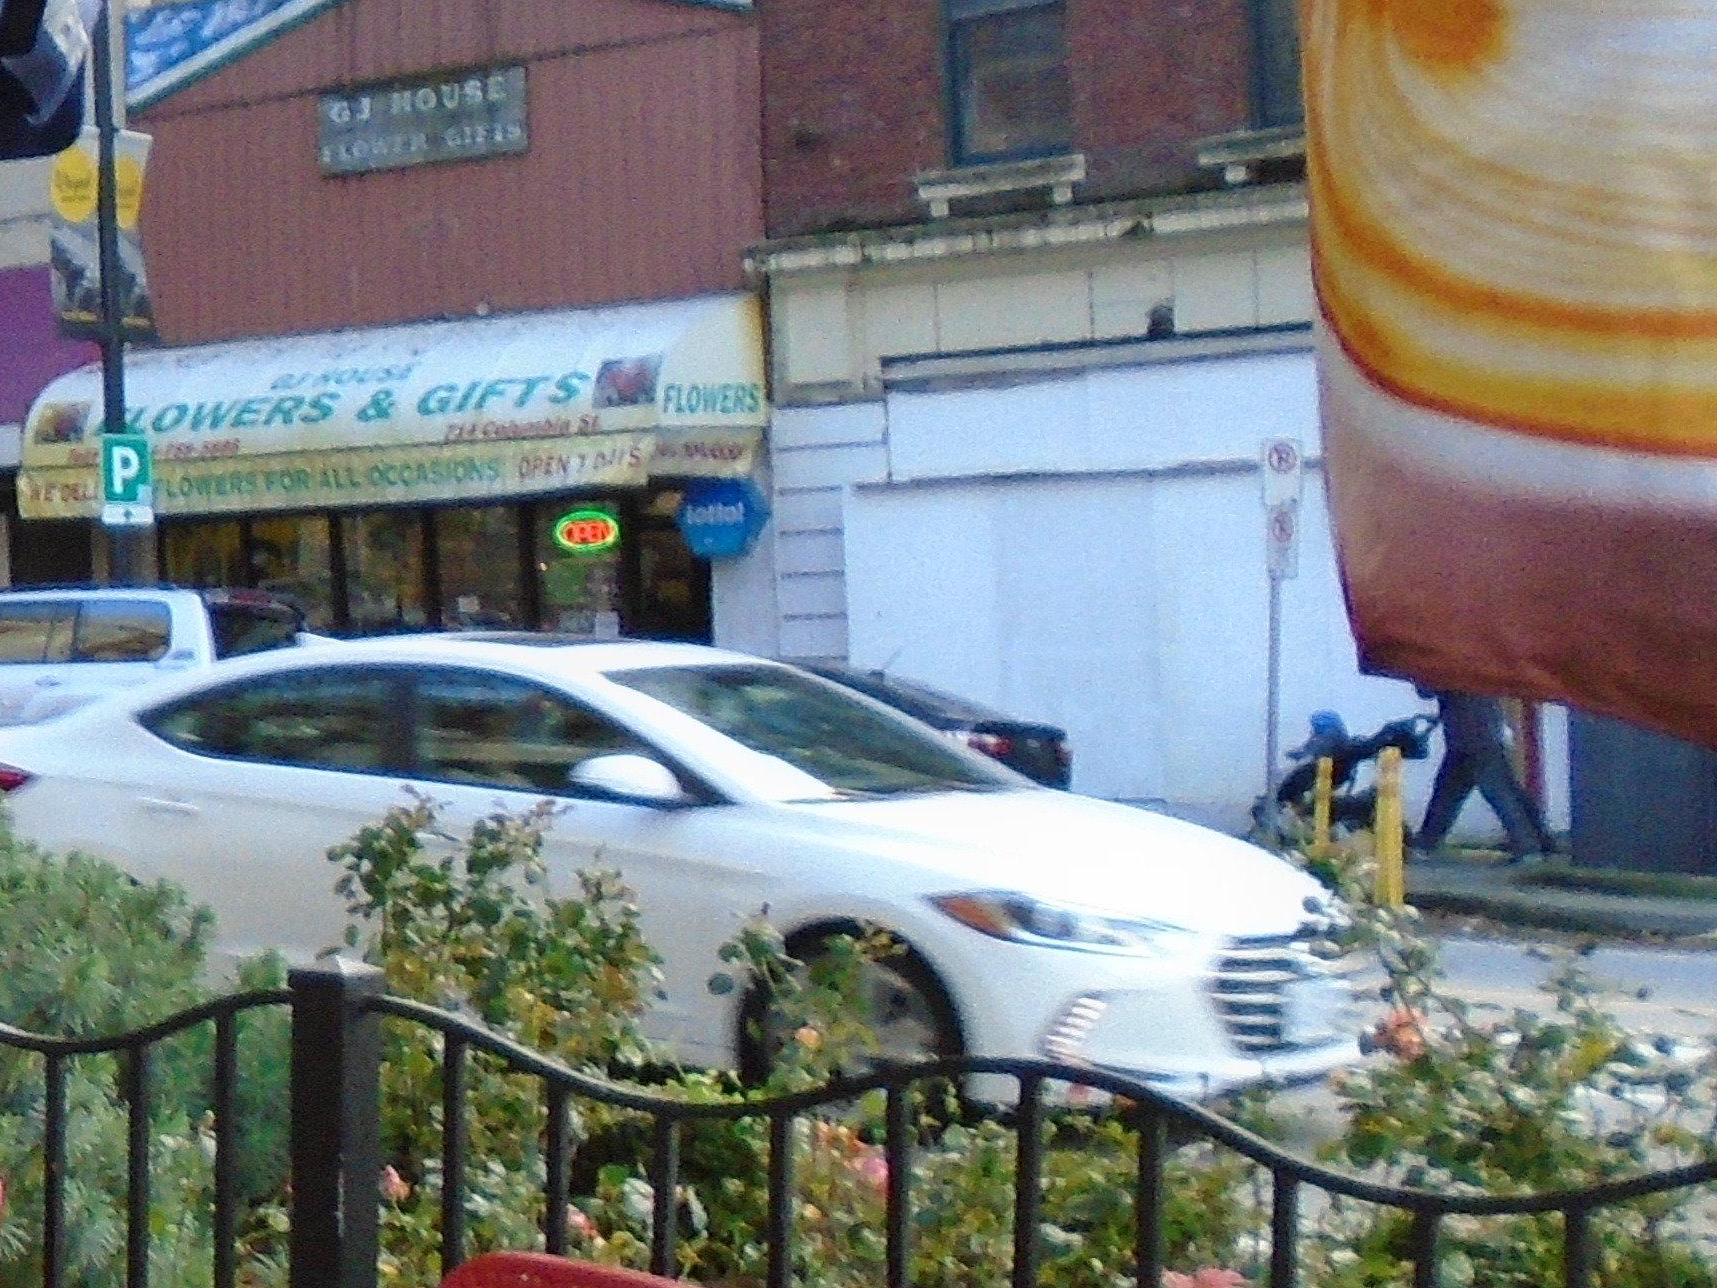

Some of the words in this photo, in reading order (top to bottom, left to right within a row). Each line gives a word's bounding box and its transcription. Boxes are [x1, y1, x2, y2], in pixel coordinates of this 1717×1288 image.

[391, 73, 507, 114] HOUSE
[97, 391, 341, 435] LOWERS
[355, 388, 394, 423] &
[416, 371, 592, 416] GIFTS
[663, 382, 759, 414] FLOWERS
[111, 445, 140, 494] P
